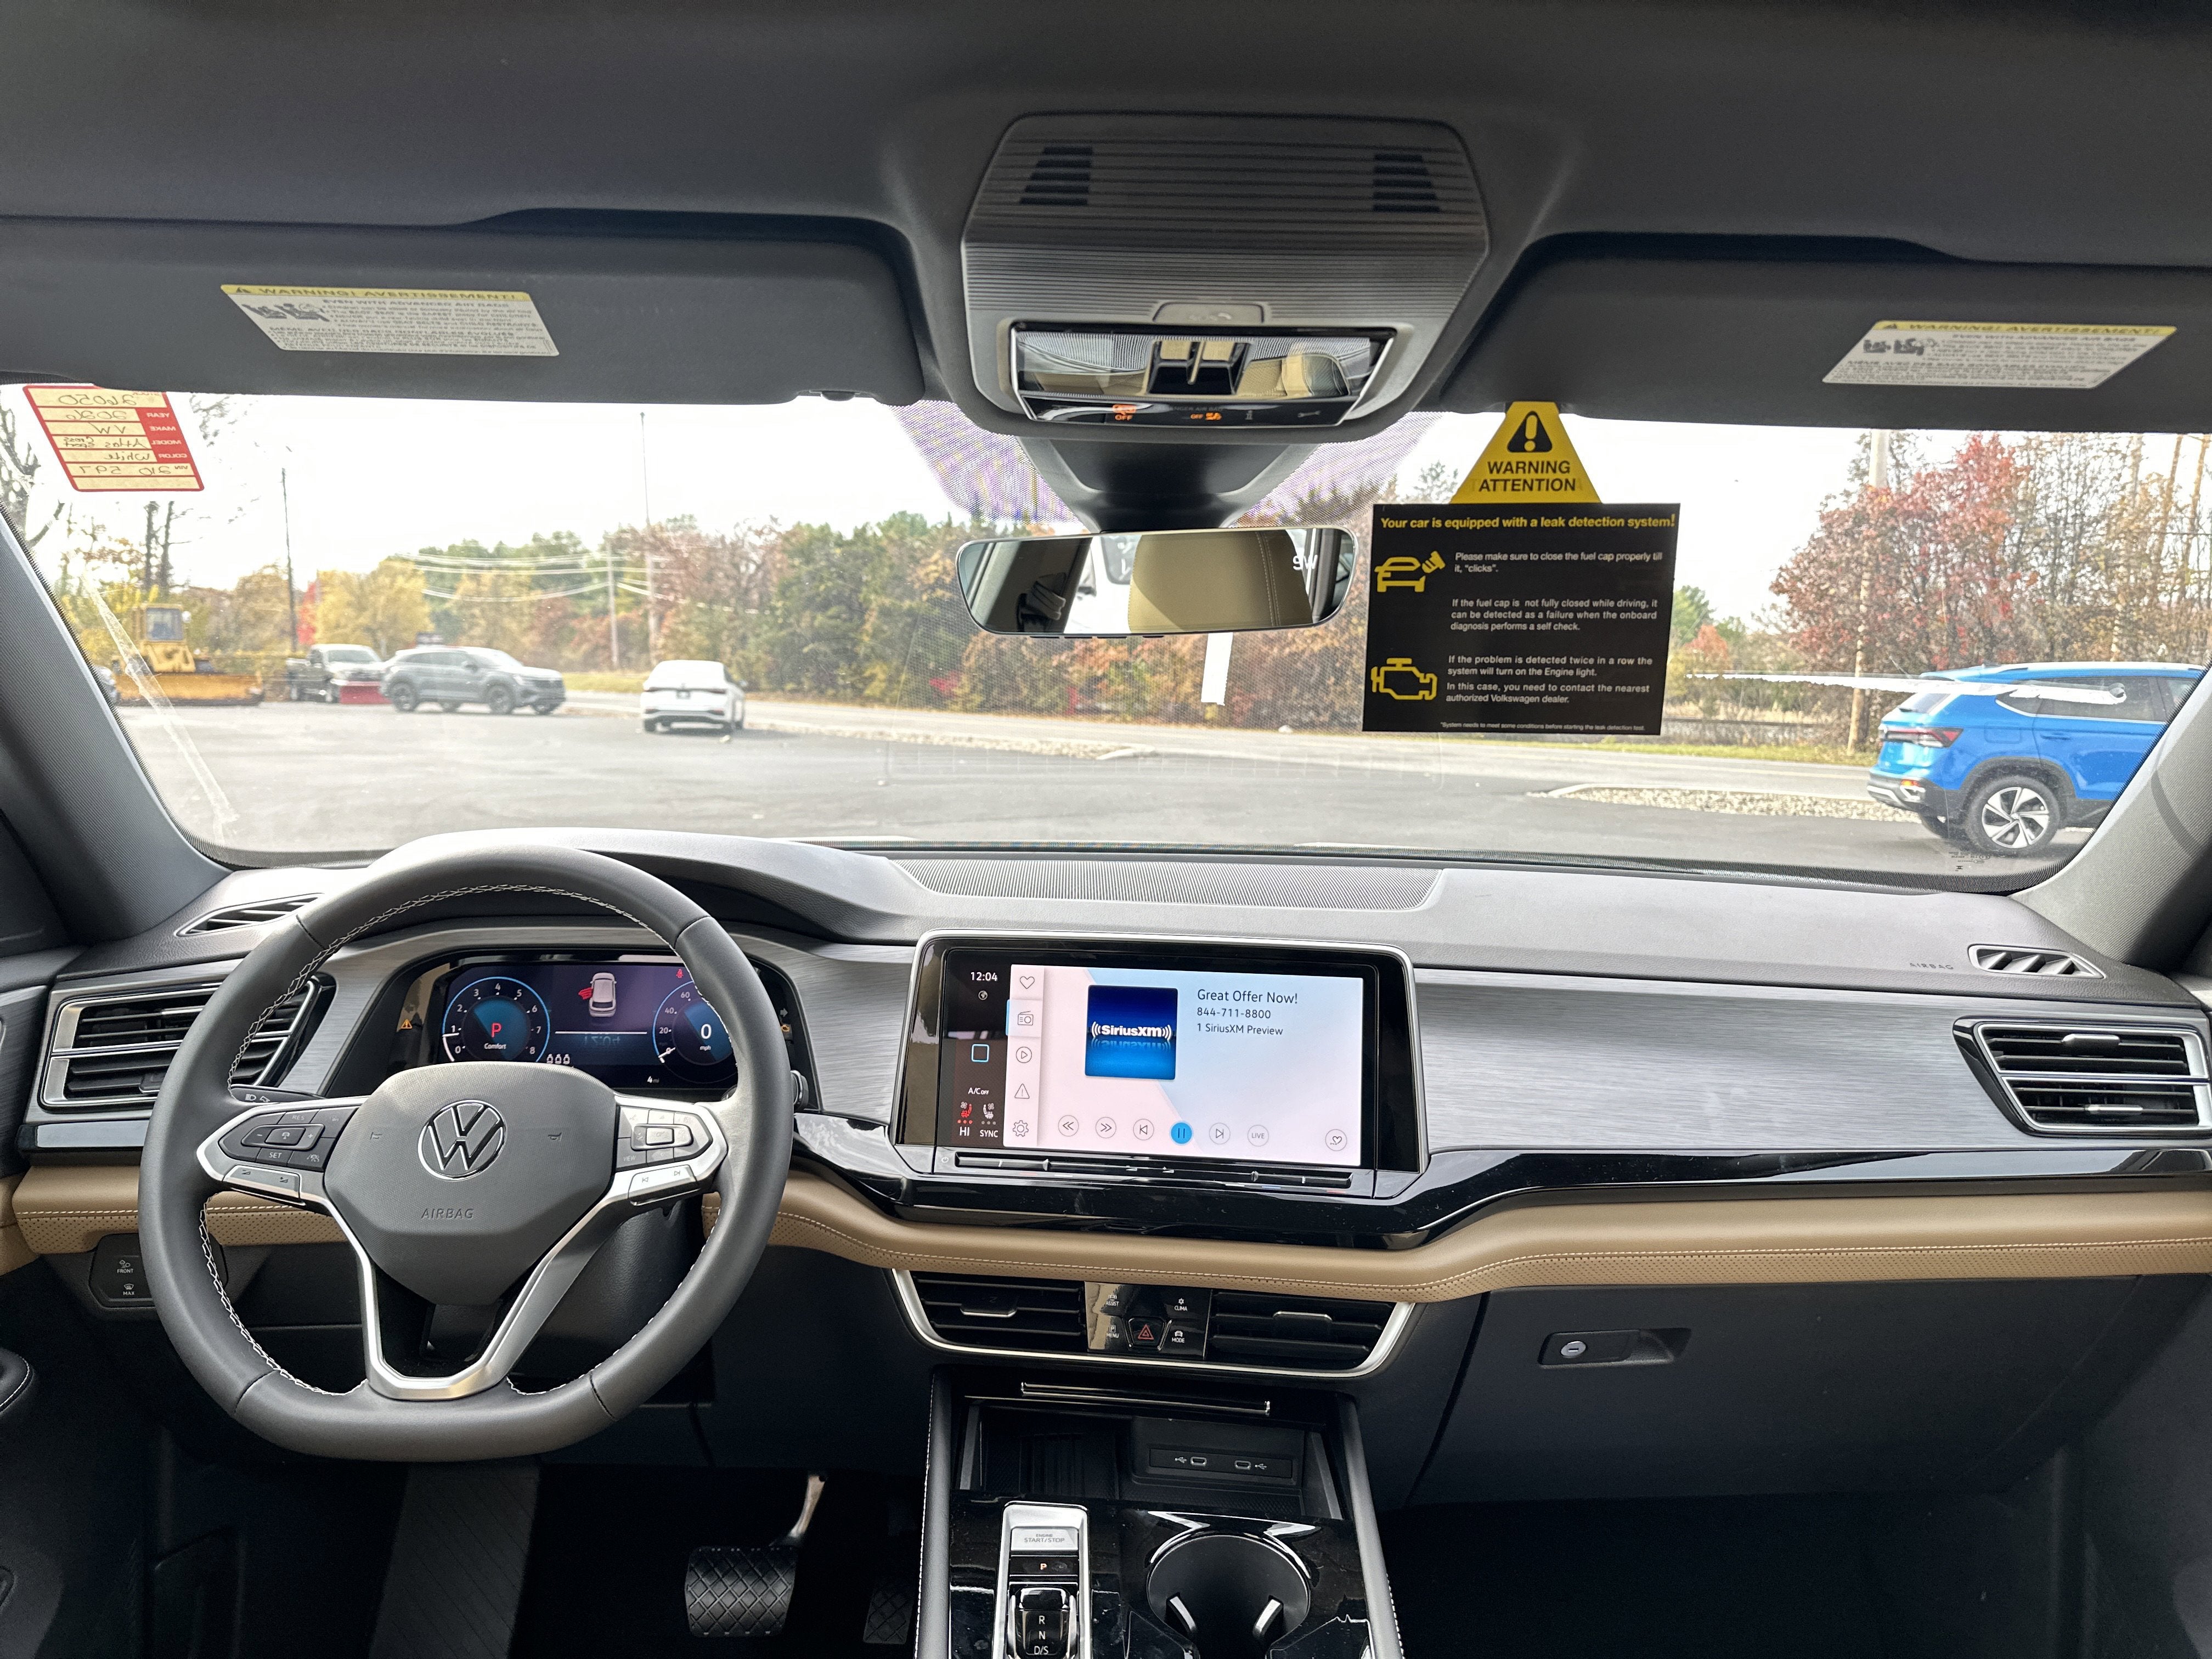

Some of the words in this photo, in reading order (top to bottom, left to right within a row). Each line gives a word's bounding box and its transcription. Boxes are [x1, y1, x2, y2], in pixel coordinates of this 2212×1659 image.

[259, 288, 355, 296] WARNING!
[1487, 460, 1571, 475] WARNING
[1478, 478, 1576, 493] ATTENTION
[1381, 517, 1407, 528] Your
[1410, 520, 1429, 528] car
[1432, 517, 1442, 528] is
[1444, 517, 1499, 529] equipped
[1502, 517, 1527, 527] with
[1530, 519, 1538, 527] a
[1541, 516, 1565, 527] leak
[1568, 516, 1624, 527] detection
[1627, 514, 1675, 529] system!
[1455, 552, 1483, 561] Please
[1485, 552, 1508, 561] make
[1540, 552, 1563, 560] close
[1565, 552, 1579, 560] the
[1580, 552, 1596, 560] fuel
[1598, 553, 1615, 562] cap
[1616, 552, 1651, 562] properly
[1652, 552, 1663, 560] till
[1454, 564, 1463, 573] it,
[1452, 599, 1459, 607] If
[1460, 599, 1474, 607] the
[1476, 599, 1492, 607] fuel
[1494, 600, 1510, 608] cap
[1512, 599, 1520, 607] is
[1541, 599, 1559, 608] fully
[1561, 599, 1590, 607] closed
[1592, 599, 1615, 607] while
[1651, 599, 1658, 607] it
[1470, 610, 1481, 618] be
[1483, 610, 1522, 618] detected
[1546, 610, 1574, 619] failure
[1576, 611, 1600, 619] when
[1602, 611, 1617, 619] the
[1620, 611, 1657, 619] onboard
[1451, 622, 1489, 631] diagnosis
[1491, 622, 1527, 631] performs
[1536, 622, 1551, 630] self
[1553, 622, 1581, 630] check.
[1448, 655, 1455, 663] If
[1458, 655, 1472, 663] the
[1474, 655, 1512, 665] problem
[1515, 656, 1523, 664] is
[1525, 656, 1567, 664] detected
[1570, 656, 1594, 664] twice
[1597, 656, 1606, 664] in
[1637, 657, 1653, 665] the
[1447, 668, 1477, 676] system
[1496, 667, 1513, 675] turn
[1528, 667, 1543, 675] the
[1544, 668, 1574, 678] Engine
[1576, 668, 1598, 678] light.
[1447, 682, 1455, 690] In
[1458, 682, 1474, 690] this
[1476, 684, 1501, 692] case,
[1522, 683, 1546, 691] need
[1548, 684, 1558, 692] to
[1560, 684, 1595, 692] contact
[1598, 684, 1612, 692] the
[1615, 684, 1650, 692] nearest
[1491, 694, 1540, 704] Volkswagen
[1542, 695, 1570, 703] dealer.
[970, 972, 998, 981] 12:04
[473, 989, 479, 997] 3
[1197, 989, 1229, 1002] Great
[1232, 990, 1263, 1002] Offer
[1267, 992, 1299, 1004] Now!
[457, 1004, 463, 1012] 2
[532, 1005, 538, 1013] 6
[1197, 1007, 1271, 1019] 844-711-8800
[491, 1022, 502, 1038] P
[701, 1023, 712, 1040] 0
[1197, 1023, 1201, 1032] 1
[1205, 1023, 1244, 1034] SiriusXM
[1247, 1025, 1284, 1036] Preview
[455, 1046, 461, 1054] 0
[529, 1046, 535, 1055] 8
[968, 1087, 980, 1095] A/C
[959, 1126, 970, 1137] HI
[979, 1129, 998, 1138] SYNC
[1251, 1132, 1266, 1140] LIVE
[421, 1208, 475, 1220] AIRBAG
[1039, 1615, 1045, 1625] R
[1039, 1630, 1046, 1640] N
[1034, 1645, 1049, 1655] D/S
